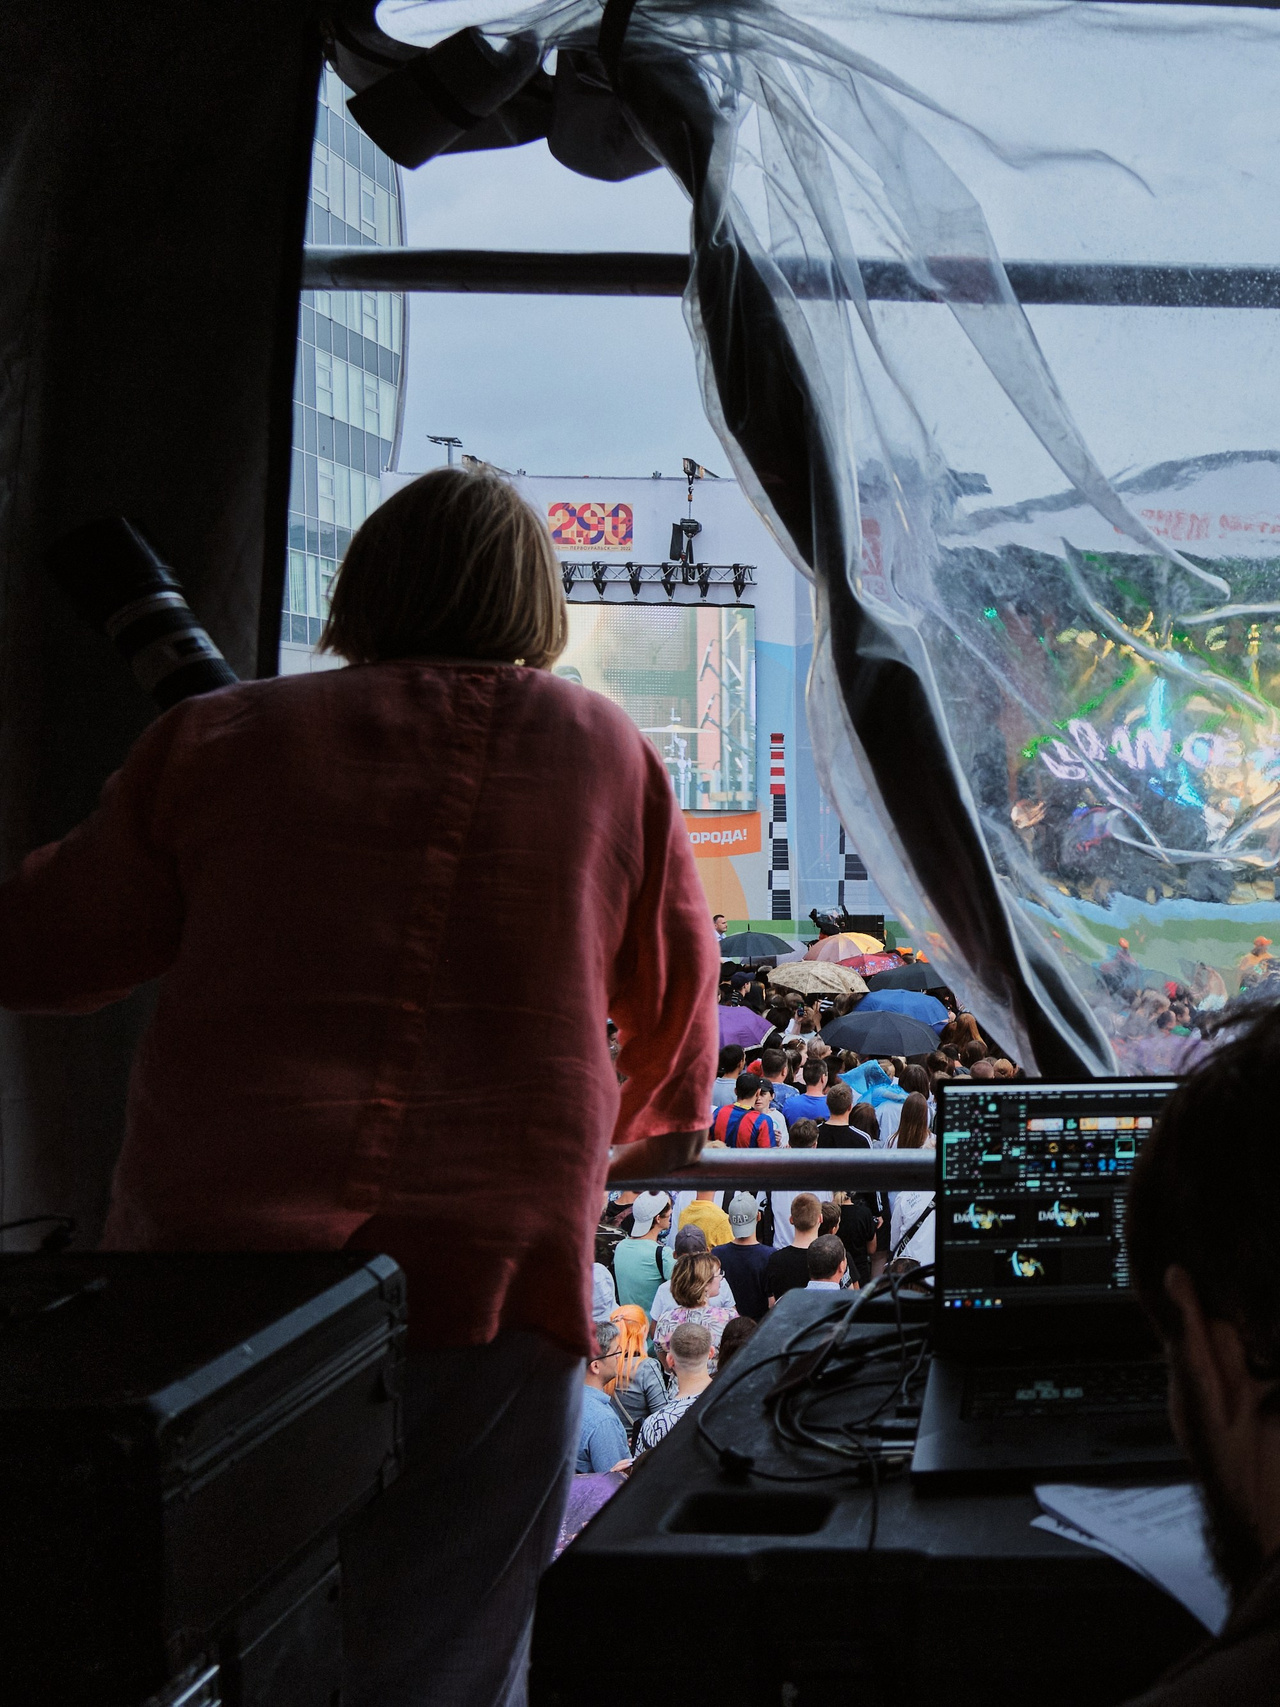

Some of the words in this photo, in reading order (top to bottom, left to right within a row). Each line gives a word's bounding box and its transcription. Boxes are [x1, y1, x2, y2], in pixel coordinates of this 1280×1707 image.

[548, 503, 633, 545] 290
[687, 828, 747, 845] ОРОДА!
[732, 1213, 749, 1224] GAP
